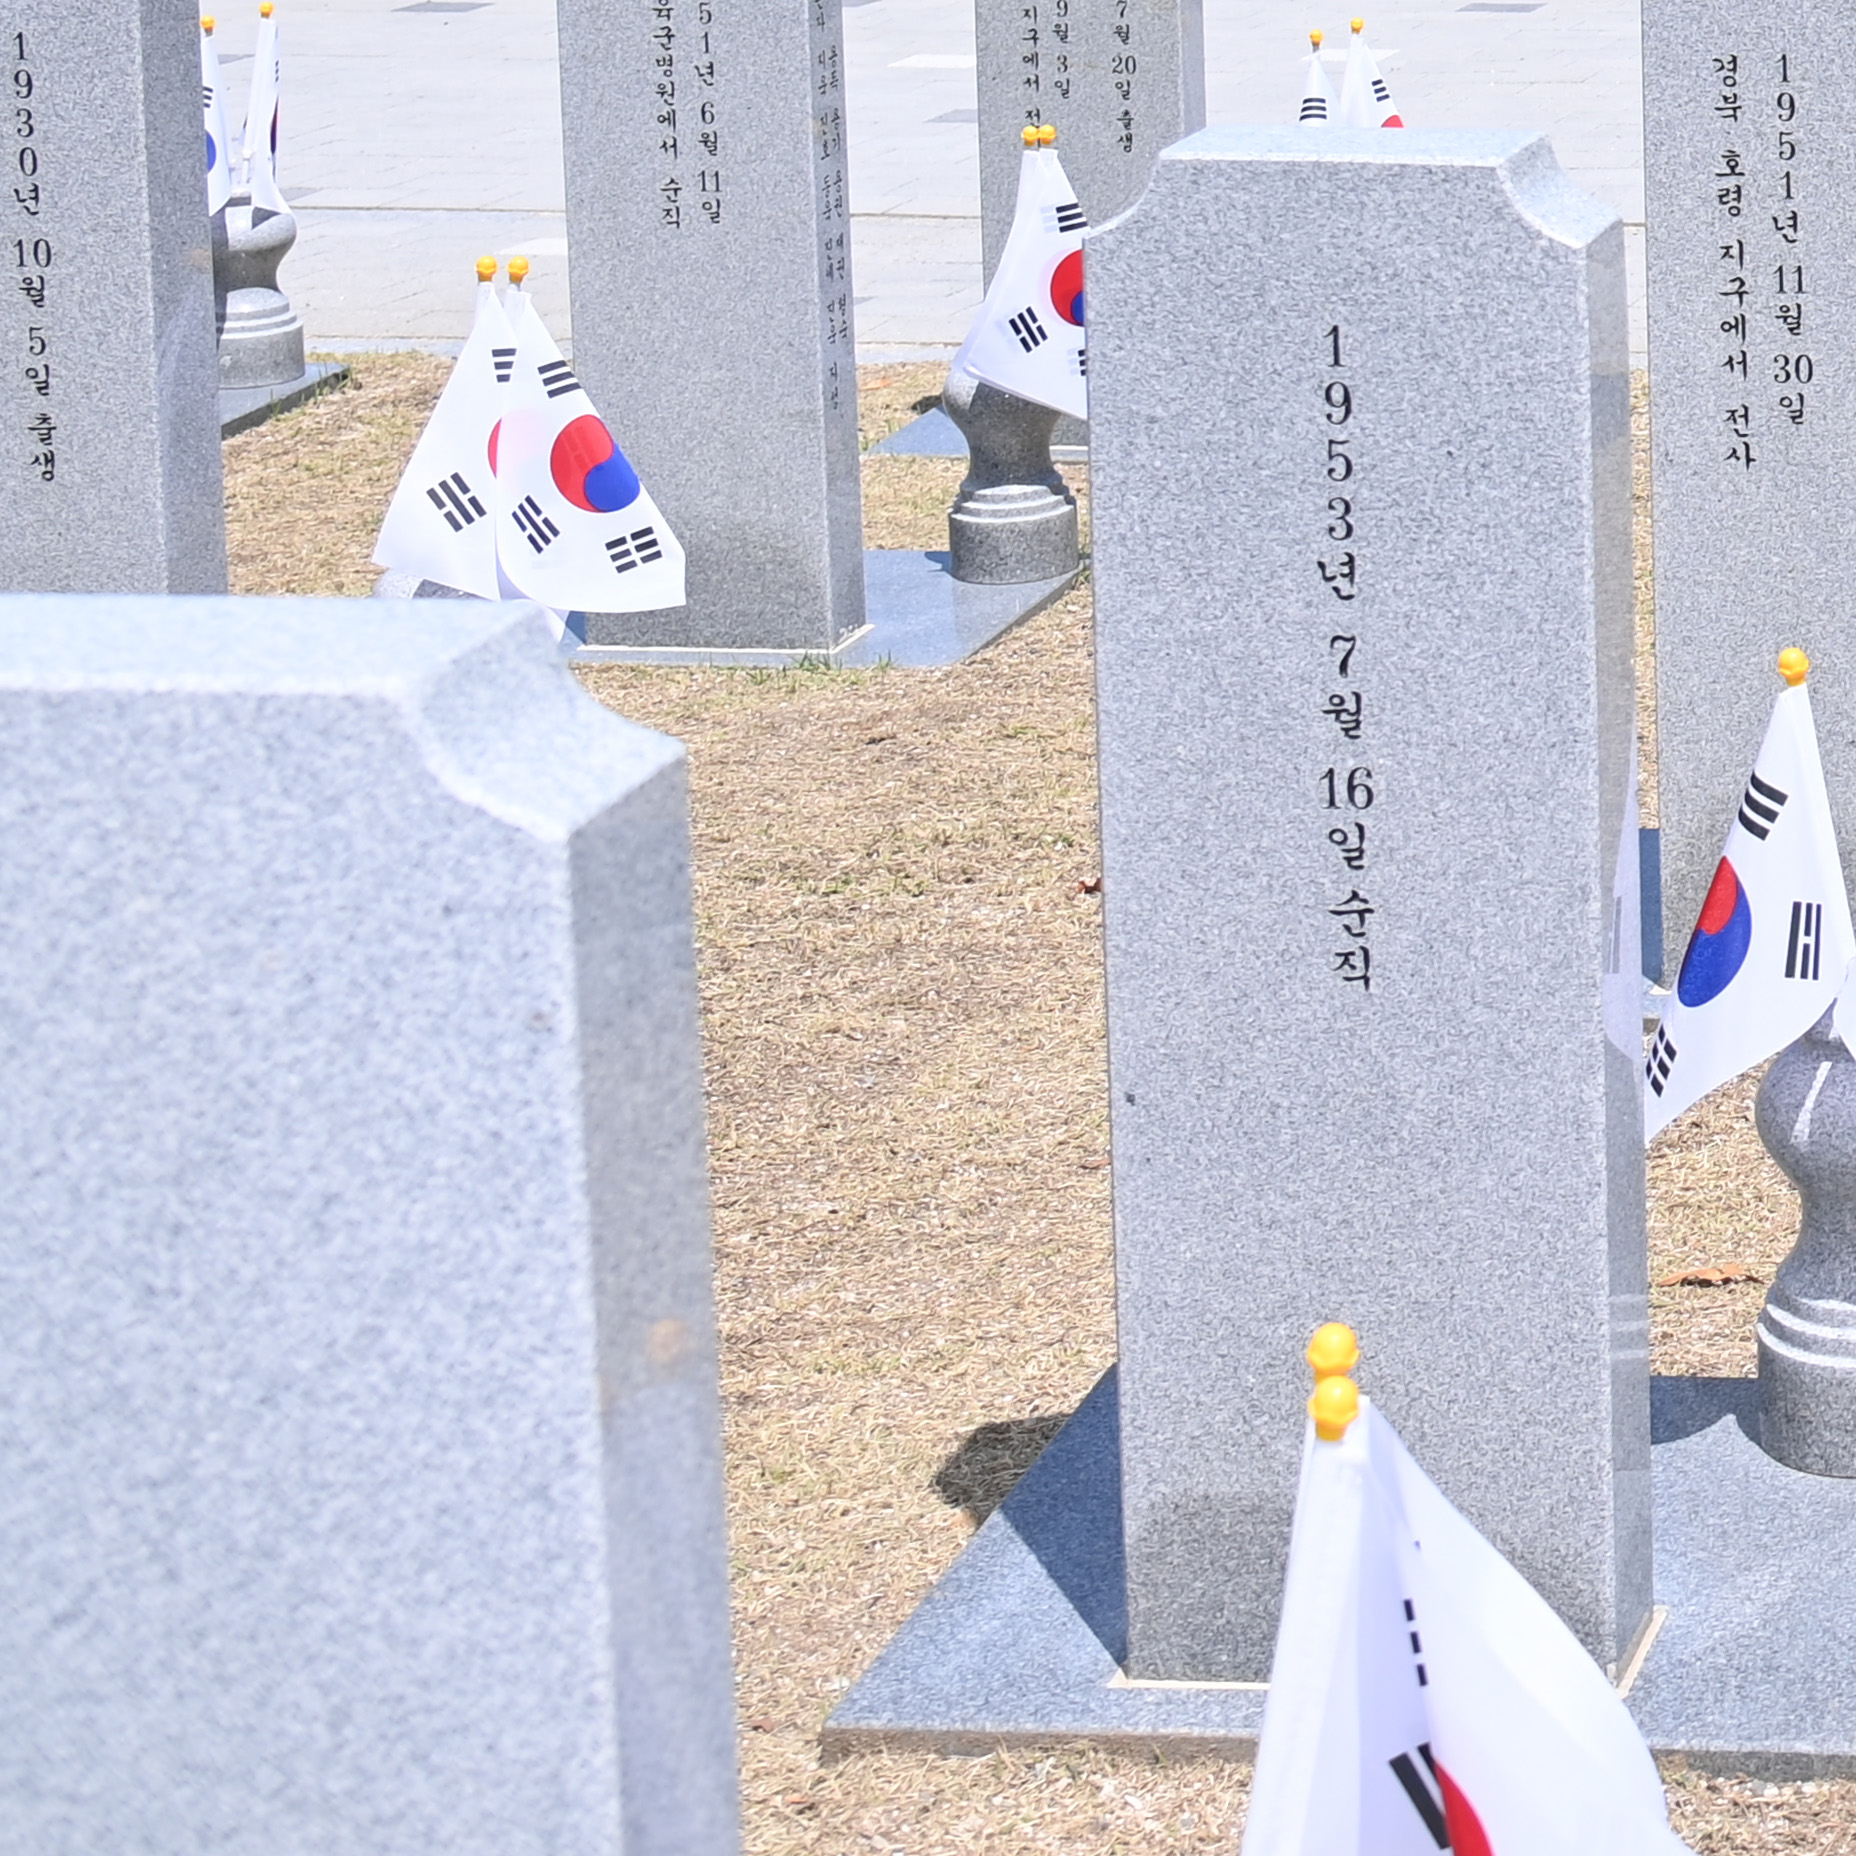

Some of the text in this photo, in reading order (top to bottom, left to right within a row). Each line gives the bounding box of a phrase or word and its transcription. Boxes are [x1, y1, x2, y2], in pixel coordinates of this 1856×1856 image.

[1053, 0, 1068, 43] 9월
[1114, 0, 1129, 45] 7월
[1023, 6, 1039, 91] 지구에서
[1055, 56, 1070, 99] 3일
[1112, 56, 1136, 100] 20일
[699, 103, 717, 156] 6월
[1118, 110, 1133, 152] 출생
[662, 178, 681, 228] 순직
[700, 171, 720, 223] 11일
[14, 32, 56, 481] 1930년 10월 5일 출생
[1713, 55, 1755, 469] 경북 호령 지구에서 전사
[1772, 54, 1813, 425] 1951년 11월 30일
[1317, 325, 1374, 990] 1953년 7월 16일 순직
